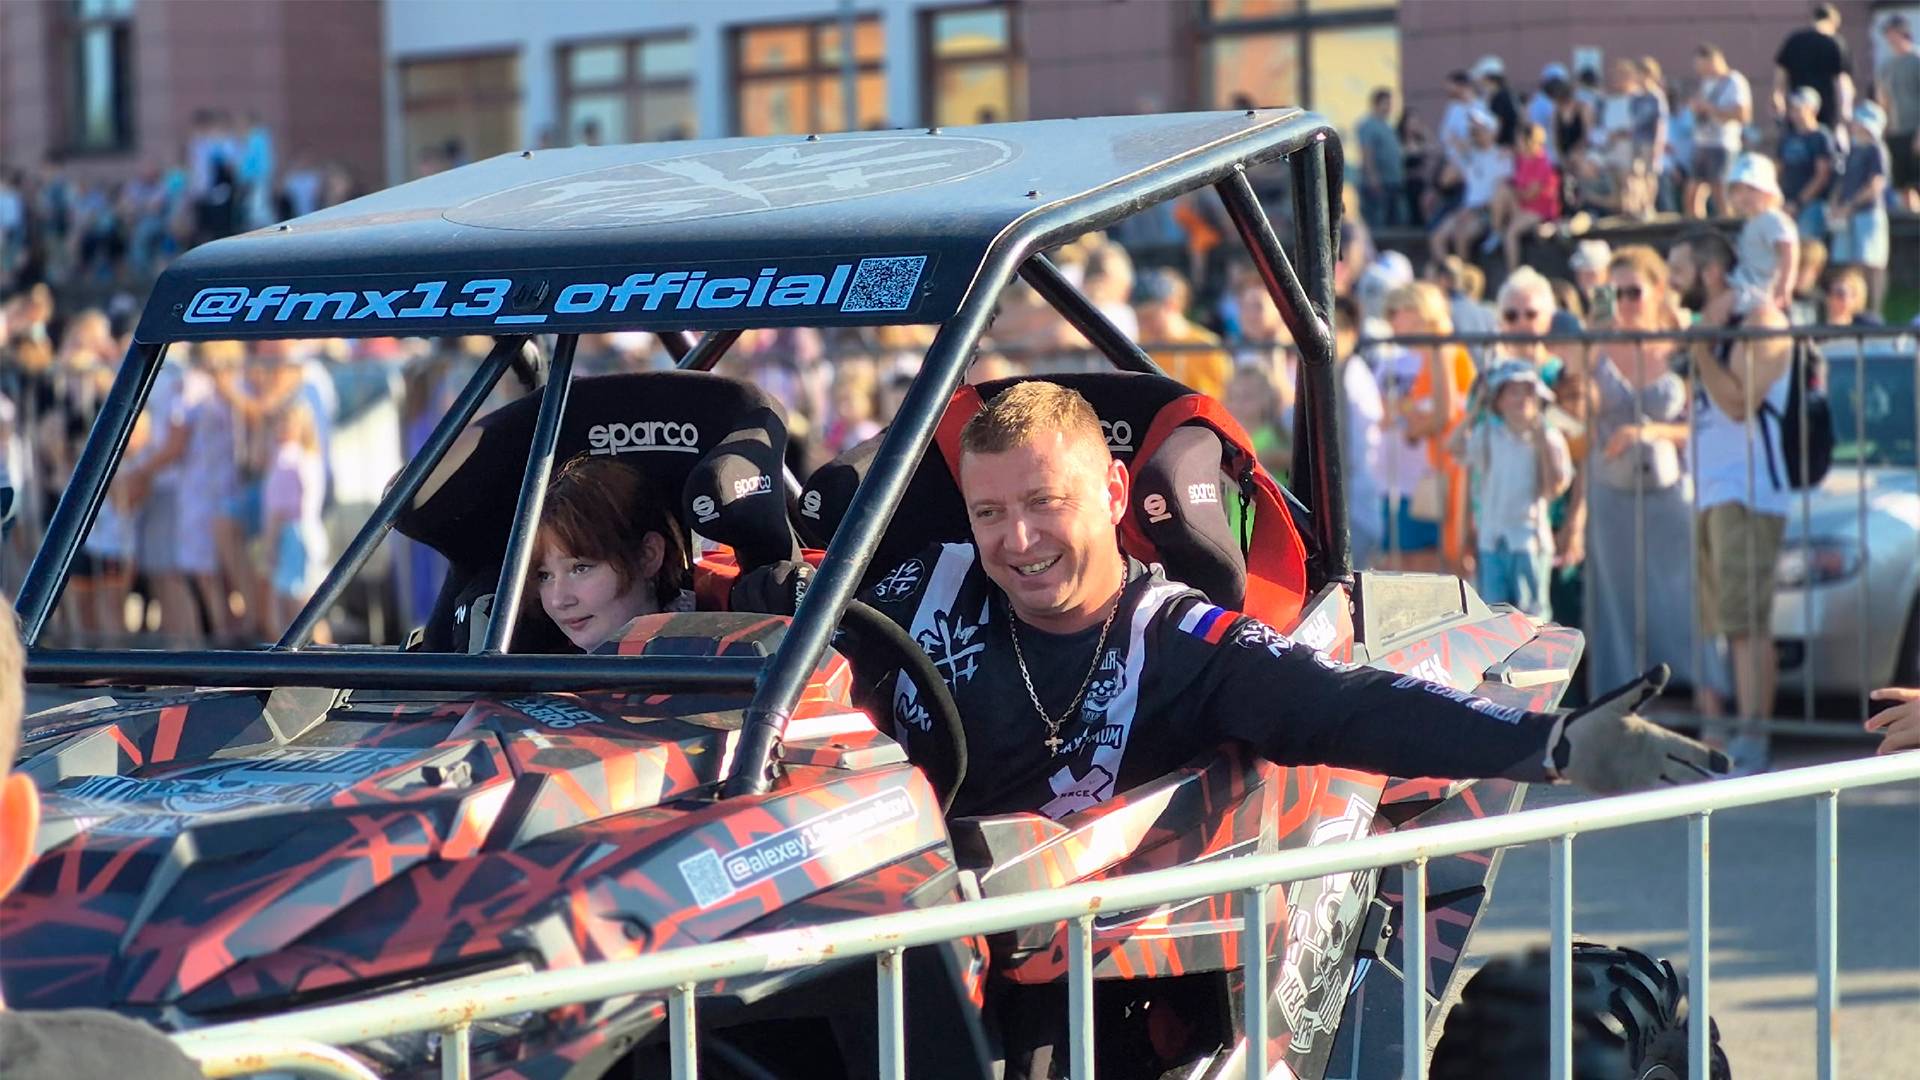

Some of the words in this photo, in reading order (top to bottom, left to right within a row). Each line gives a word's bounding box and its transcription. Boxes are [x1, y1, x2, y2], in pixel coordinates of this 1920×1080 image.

[182, 264, 852, 324] @fmx13_official
[589, 421, 699, 456] sparco
[734, 475, 772, 498] sparco
[1188, 483, 1218, 504] sparco
